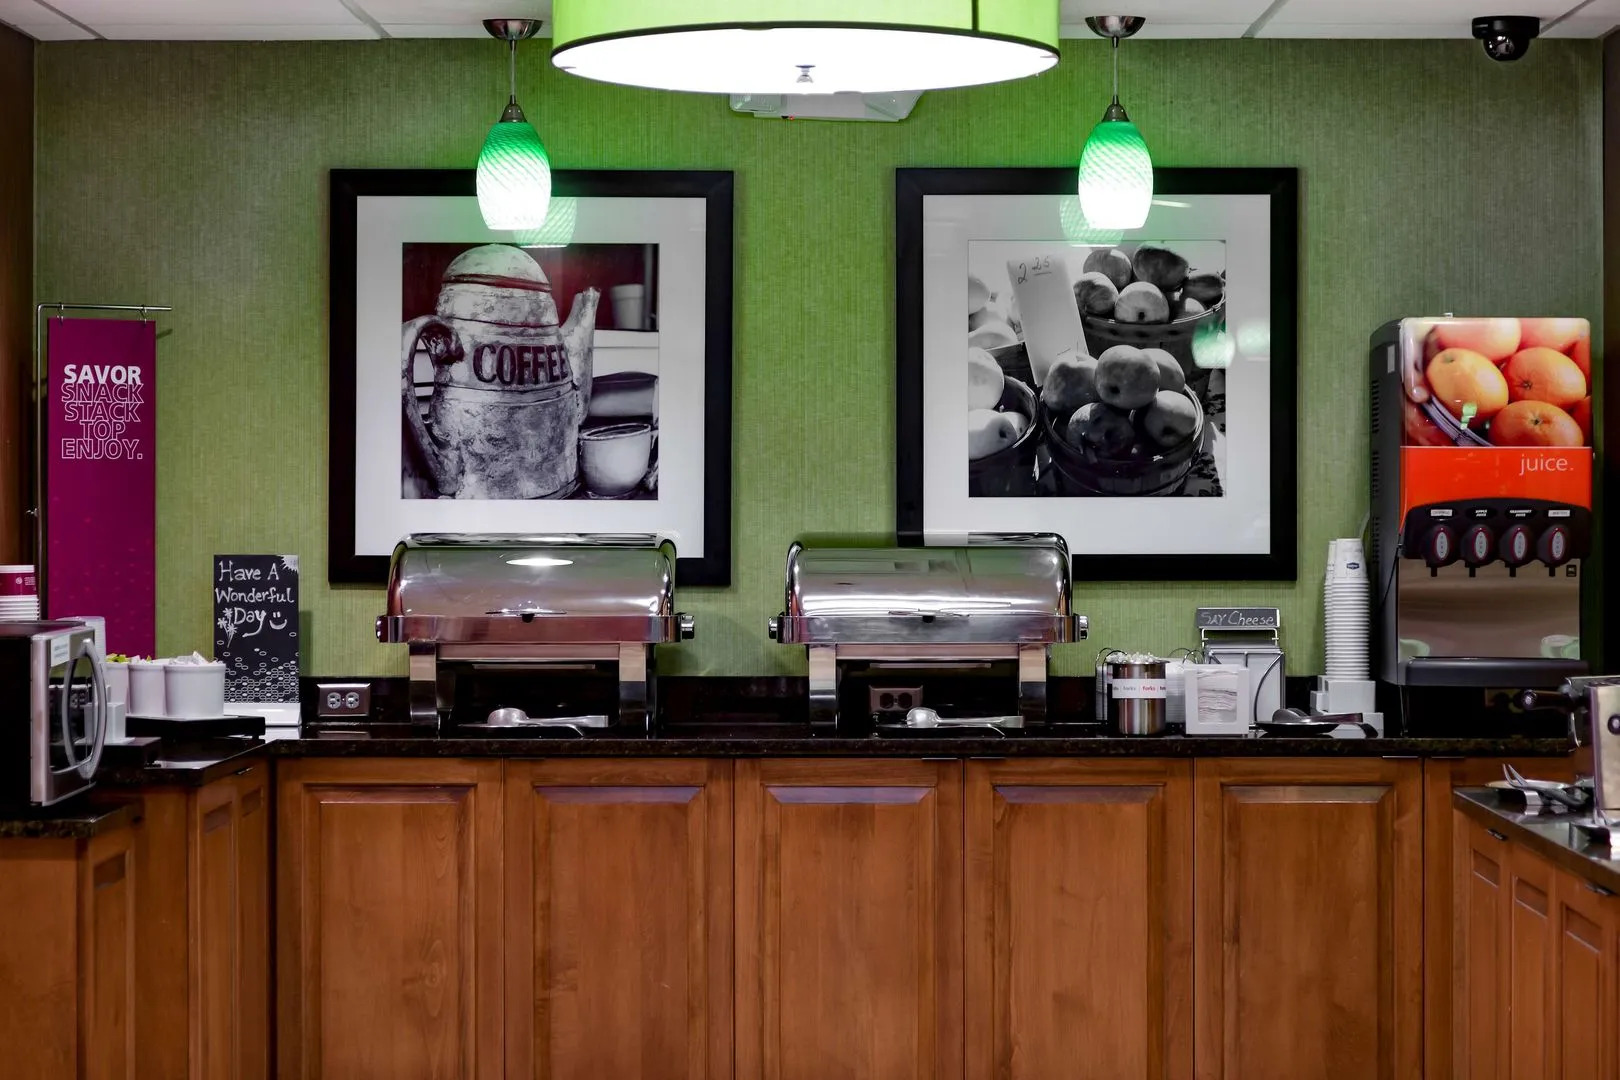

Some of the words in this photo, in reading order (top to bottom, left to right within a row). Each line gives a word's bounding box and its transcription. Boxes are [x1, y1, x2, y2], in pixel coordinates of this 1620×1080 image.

[63, 364, 141, 385] SAVOR
[473, 343, 569, 385] COFFEE
[61, 382, 144, 404] SNACK
[64, 401, 141, 422] STACK
[79, 419, 126, 441] TOP
[61, 438, 143, 460] ENJOY.
[1519, 453, 1574, 476] juice.
[219, 560, 262, 581] Have
[267, 562, 279, 580] A
[214, 587, 295, 604] Wonderful
[233, 607, 267, 637] Day
[1228, 610, 1275, 626] Cheese
